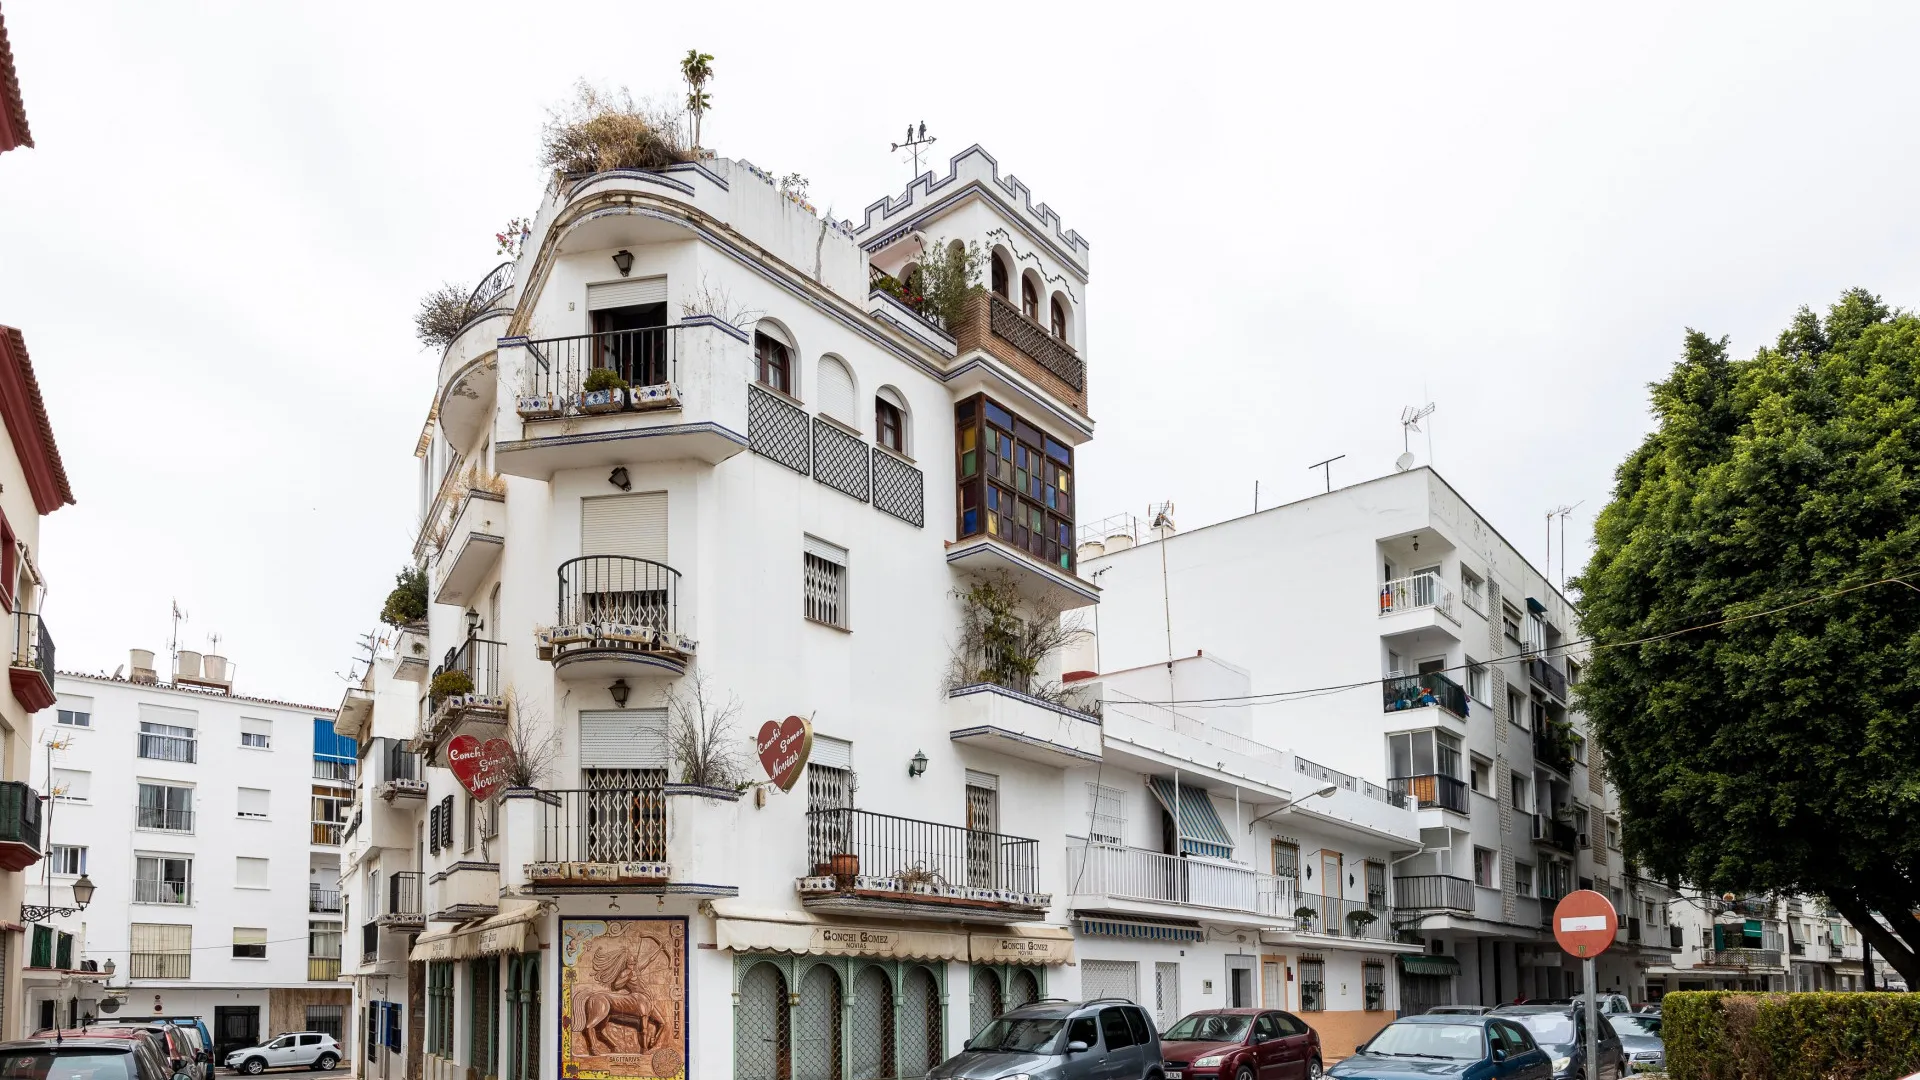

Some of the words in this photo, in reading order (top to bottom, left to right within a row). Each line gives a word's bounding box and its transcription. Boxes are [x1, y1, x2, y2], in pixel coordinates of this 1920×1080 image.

[450, 746, 485, 760] Conchi
[758, 728, 781, 755] Conchi
[780, 727, 805, 753] Gómez
[771, 750, 799, 779] Novias
[860, 932, 889, 944] GOMEZ
[1027, 941, 1049, 951] GOMEZ
[669, 923, 684, 985] CONCHI
[669, 986, 683, 1040] GOMEZ
